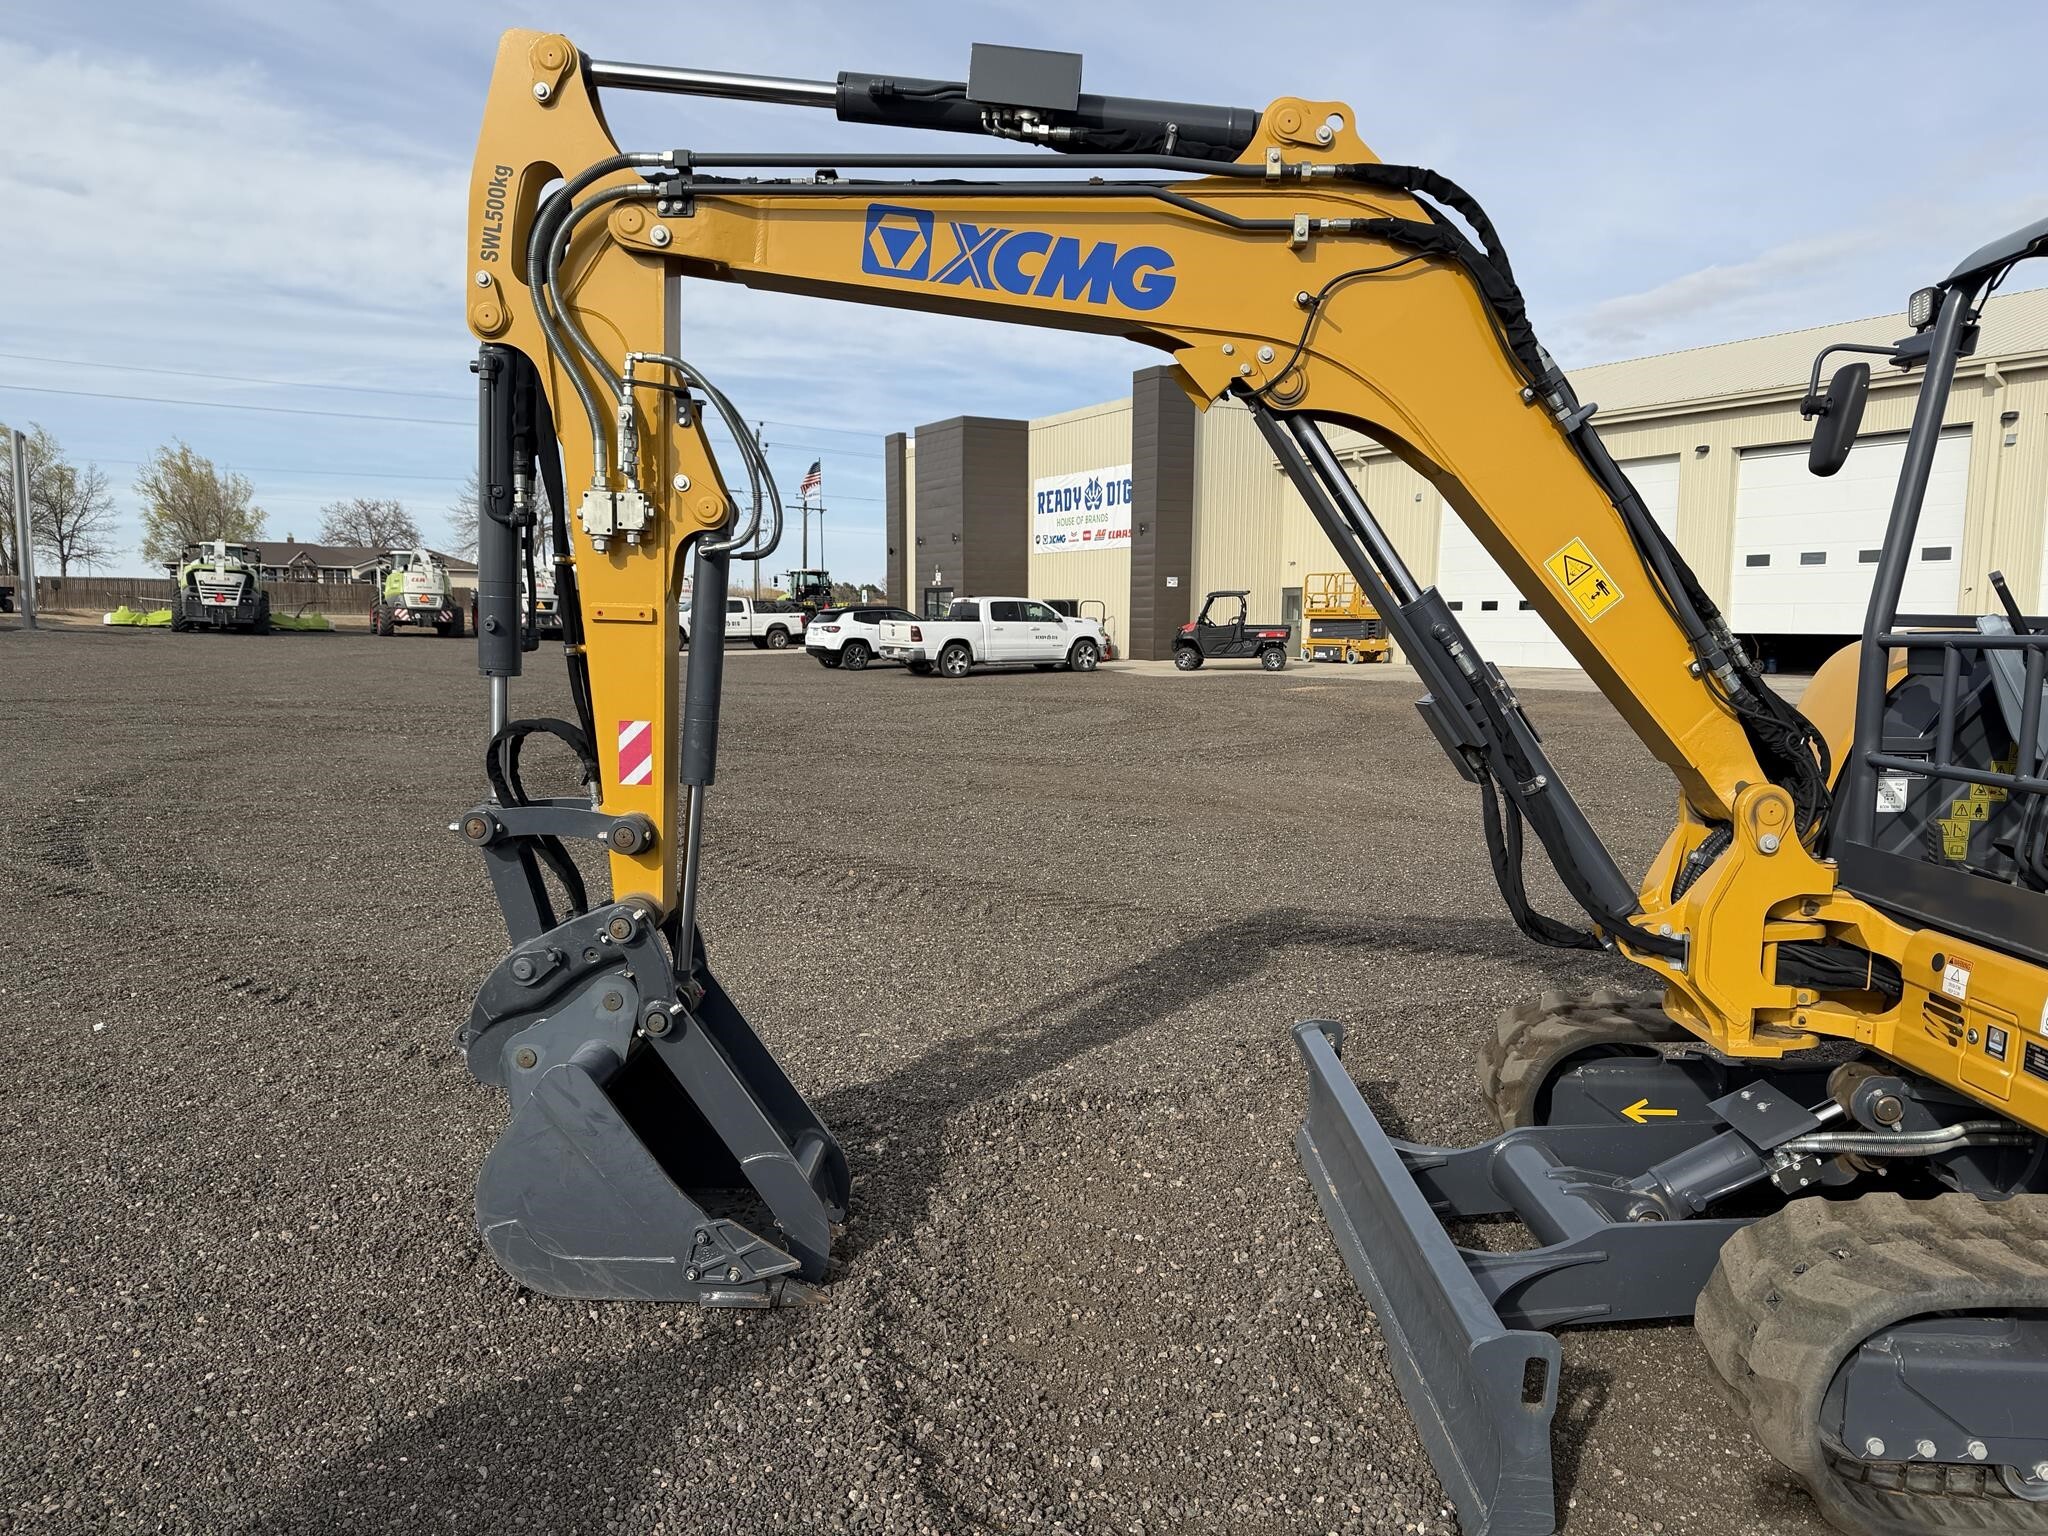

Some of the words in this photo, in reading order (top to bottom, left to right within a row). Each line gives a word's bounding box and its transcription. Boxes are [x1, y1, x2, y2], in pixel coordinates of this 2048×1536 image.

[480, 164, 514, 262] SWL500kg
[928, 222, 1177, 311] XCMG
[1037, 486, 1082, 514] READY
[1106, 478, 1132, 506] DIG
[1056, 517, 1075, 527] HOUSE
[1076, 516, 1084, 525] OF
[1085, 513, 1109, 524] BRANDS
[1049, 534, 1066, 544] XCMG
